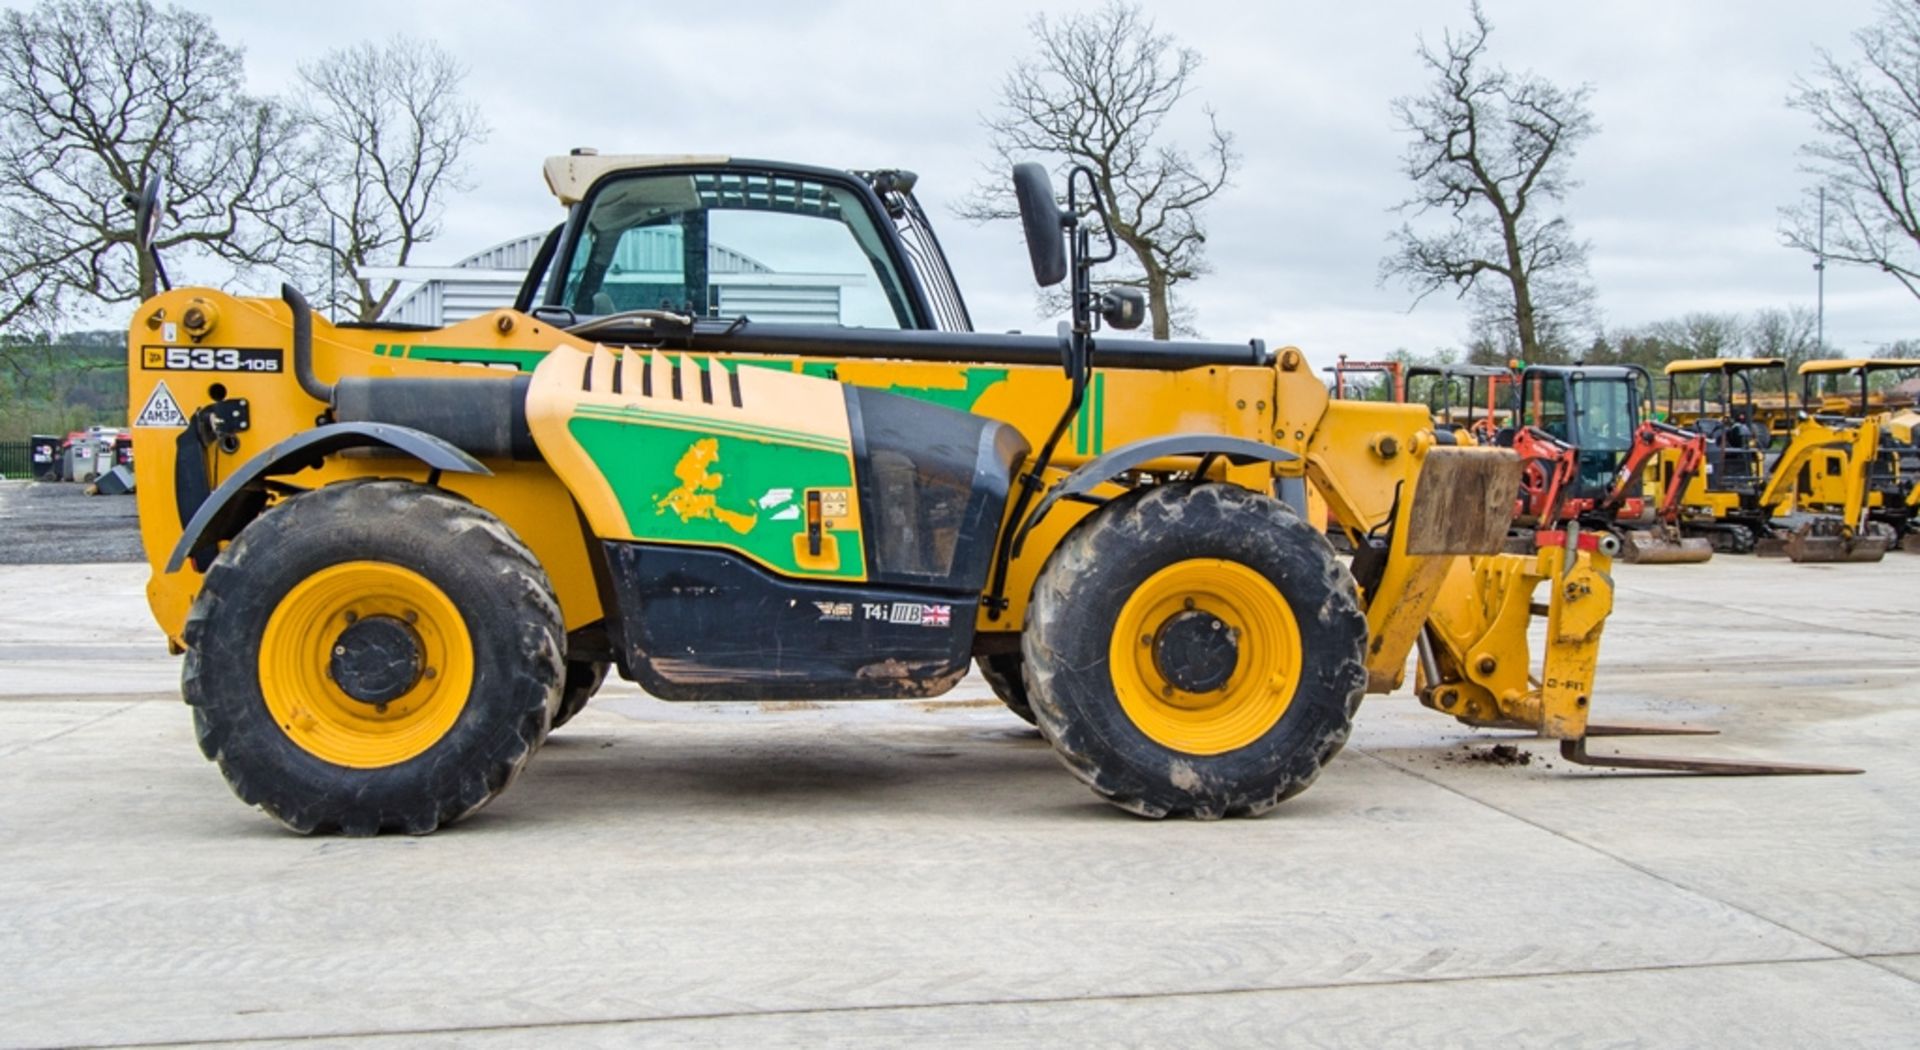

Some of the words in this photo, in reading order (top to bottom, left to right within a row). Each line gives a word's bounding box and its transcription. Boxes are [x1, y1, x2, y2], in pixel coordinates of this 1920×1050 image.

[166, 348, 279, 370] 533-105
[155, 399, 169, 409] 61
[147, 410, 177, 422] AM3P
[862, 603, 889, 620] T4i
